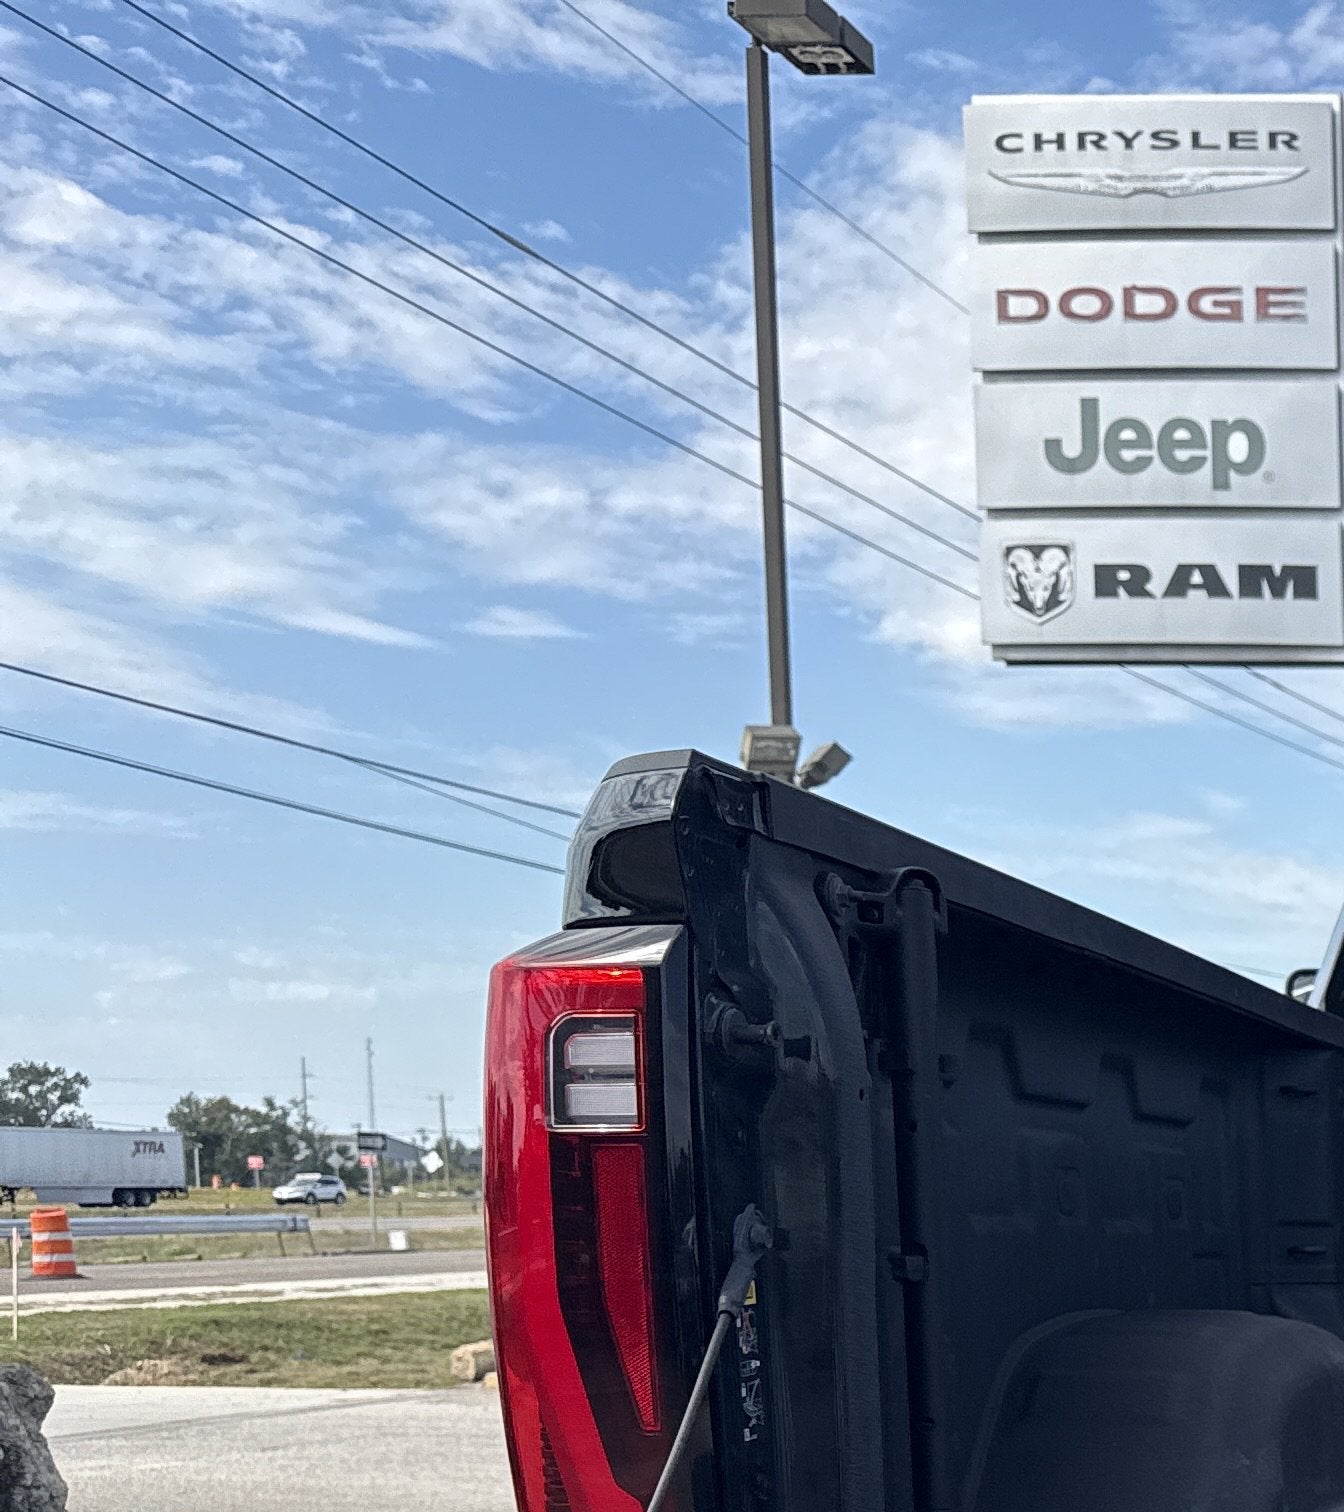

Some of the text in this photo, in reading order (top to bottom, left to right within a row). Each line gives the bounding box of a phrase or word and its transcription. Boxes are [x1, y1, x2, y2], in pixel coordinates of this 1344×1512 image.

[994, 130, 1301, 154] CHRYSLER
[996, 285, 1308, 324] DODGE
[1044, 397, 1267, 491] Jeep
[1093, 563, 1318, 600] RAM
[131, 1140, 165, 1158] XTRA
